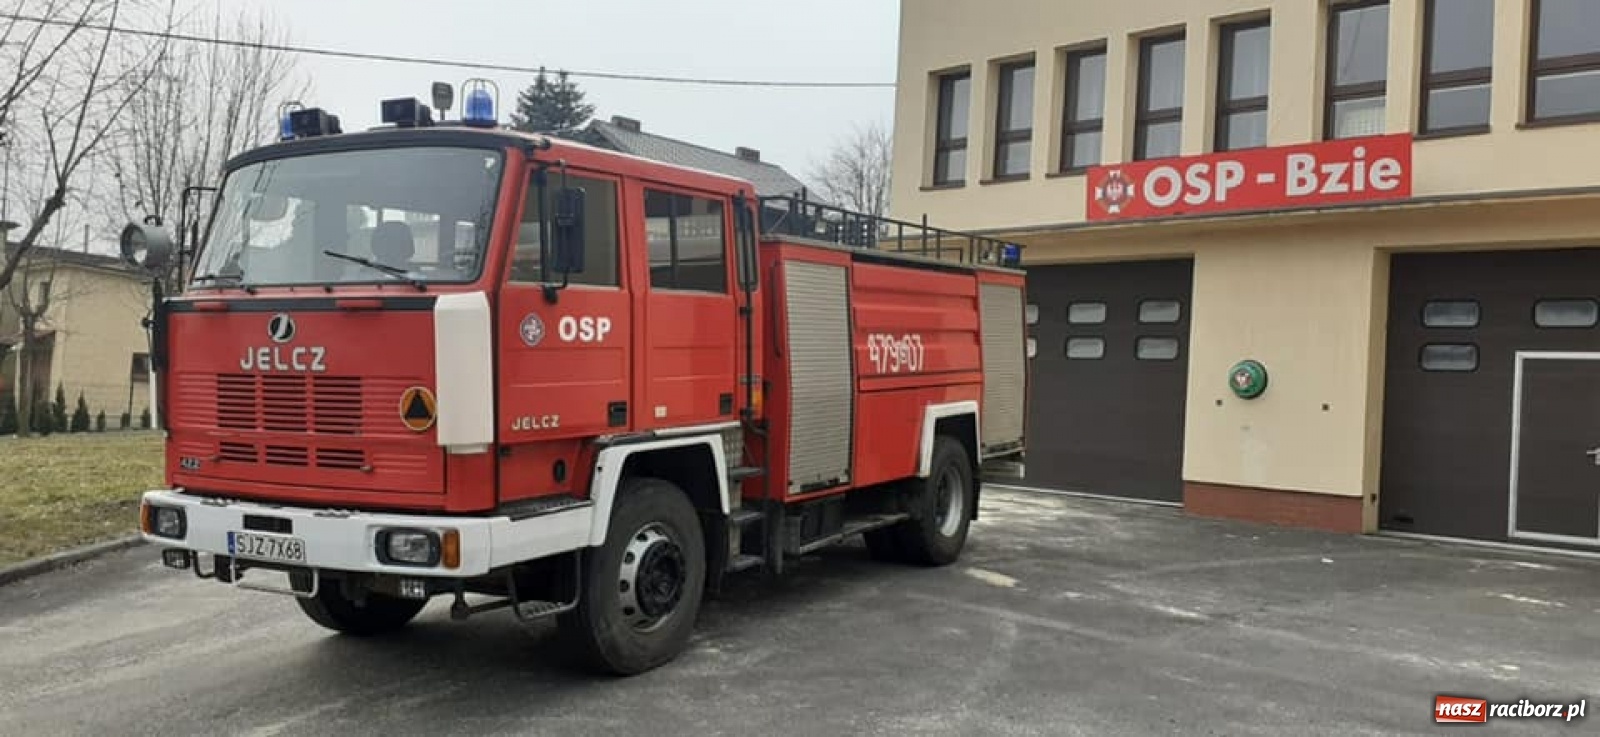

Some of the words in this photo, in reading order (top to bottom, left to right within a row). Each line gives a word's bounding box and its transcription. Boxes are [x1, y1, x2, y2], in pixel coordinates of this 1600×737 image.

[1142, 160, 1245, 208] OSP
[1285, 146, 1402, 197] Bzie
[558, 315, 612, 342] OSP
[240, 346, 326, 371] JELCZ
[511, 414, 560, 431] JELCZ
